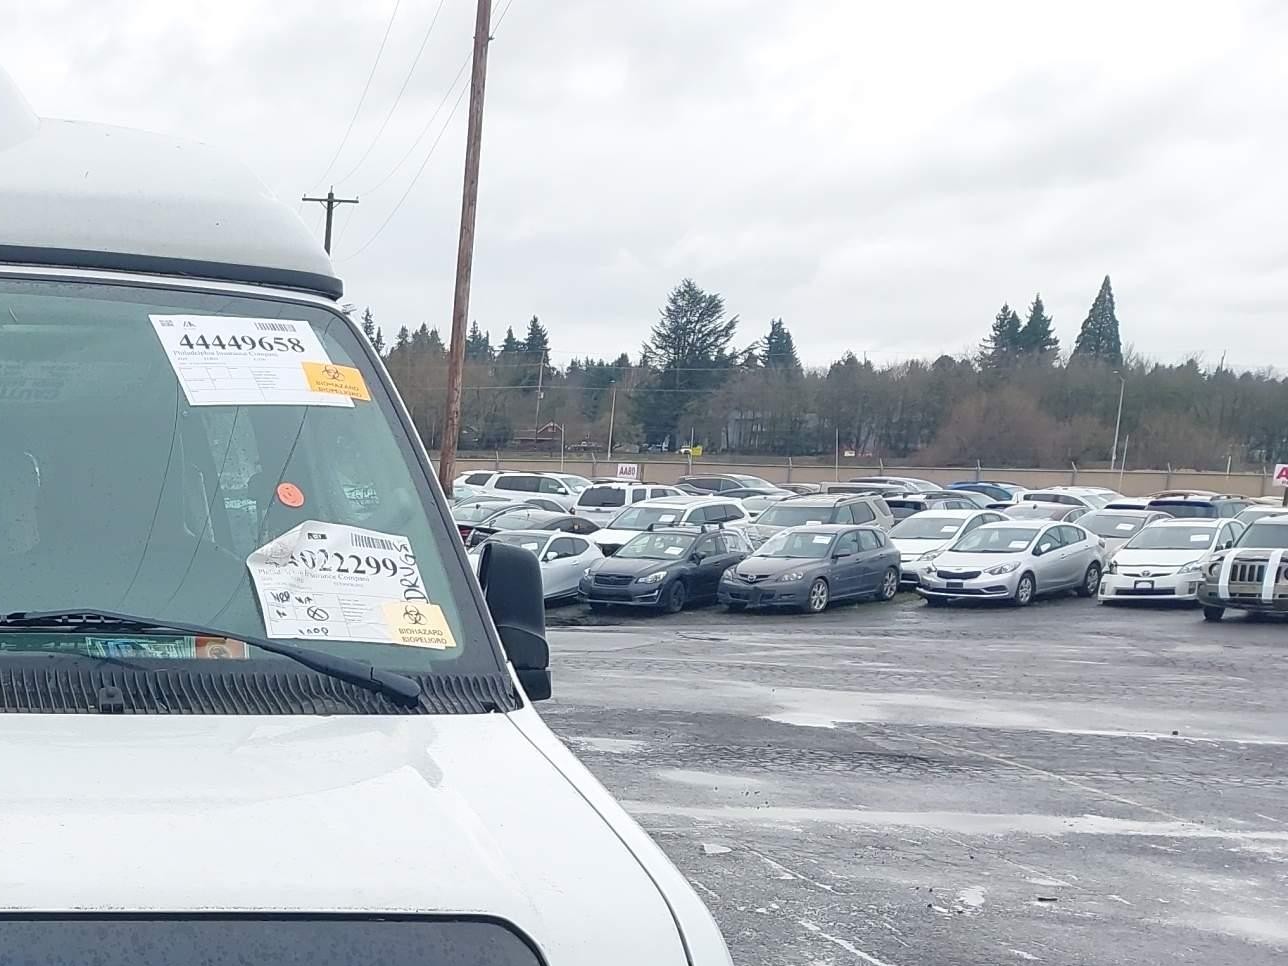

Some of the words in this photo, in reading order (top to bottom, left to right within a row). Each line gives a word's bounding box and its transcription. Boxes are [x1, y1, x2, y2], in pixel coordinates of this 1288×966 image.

[179, 334, 306, 353] 44449658
[393, 543, 431, 604] DRUGS
[398, 628, 444, 637] BIOHAZARD
[402, 636, 448, 645] BIOPELIGRO
